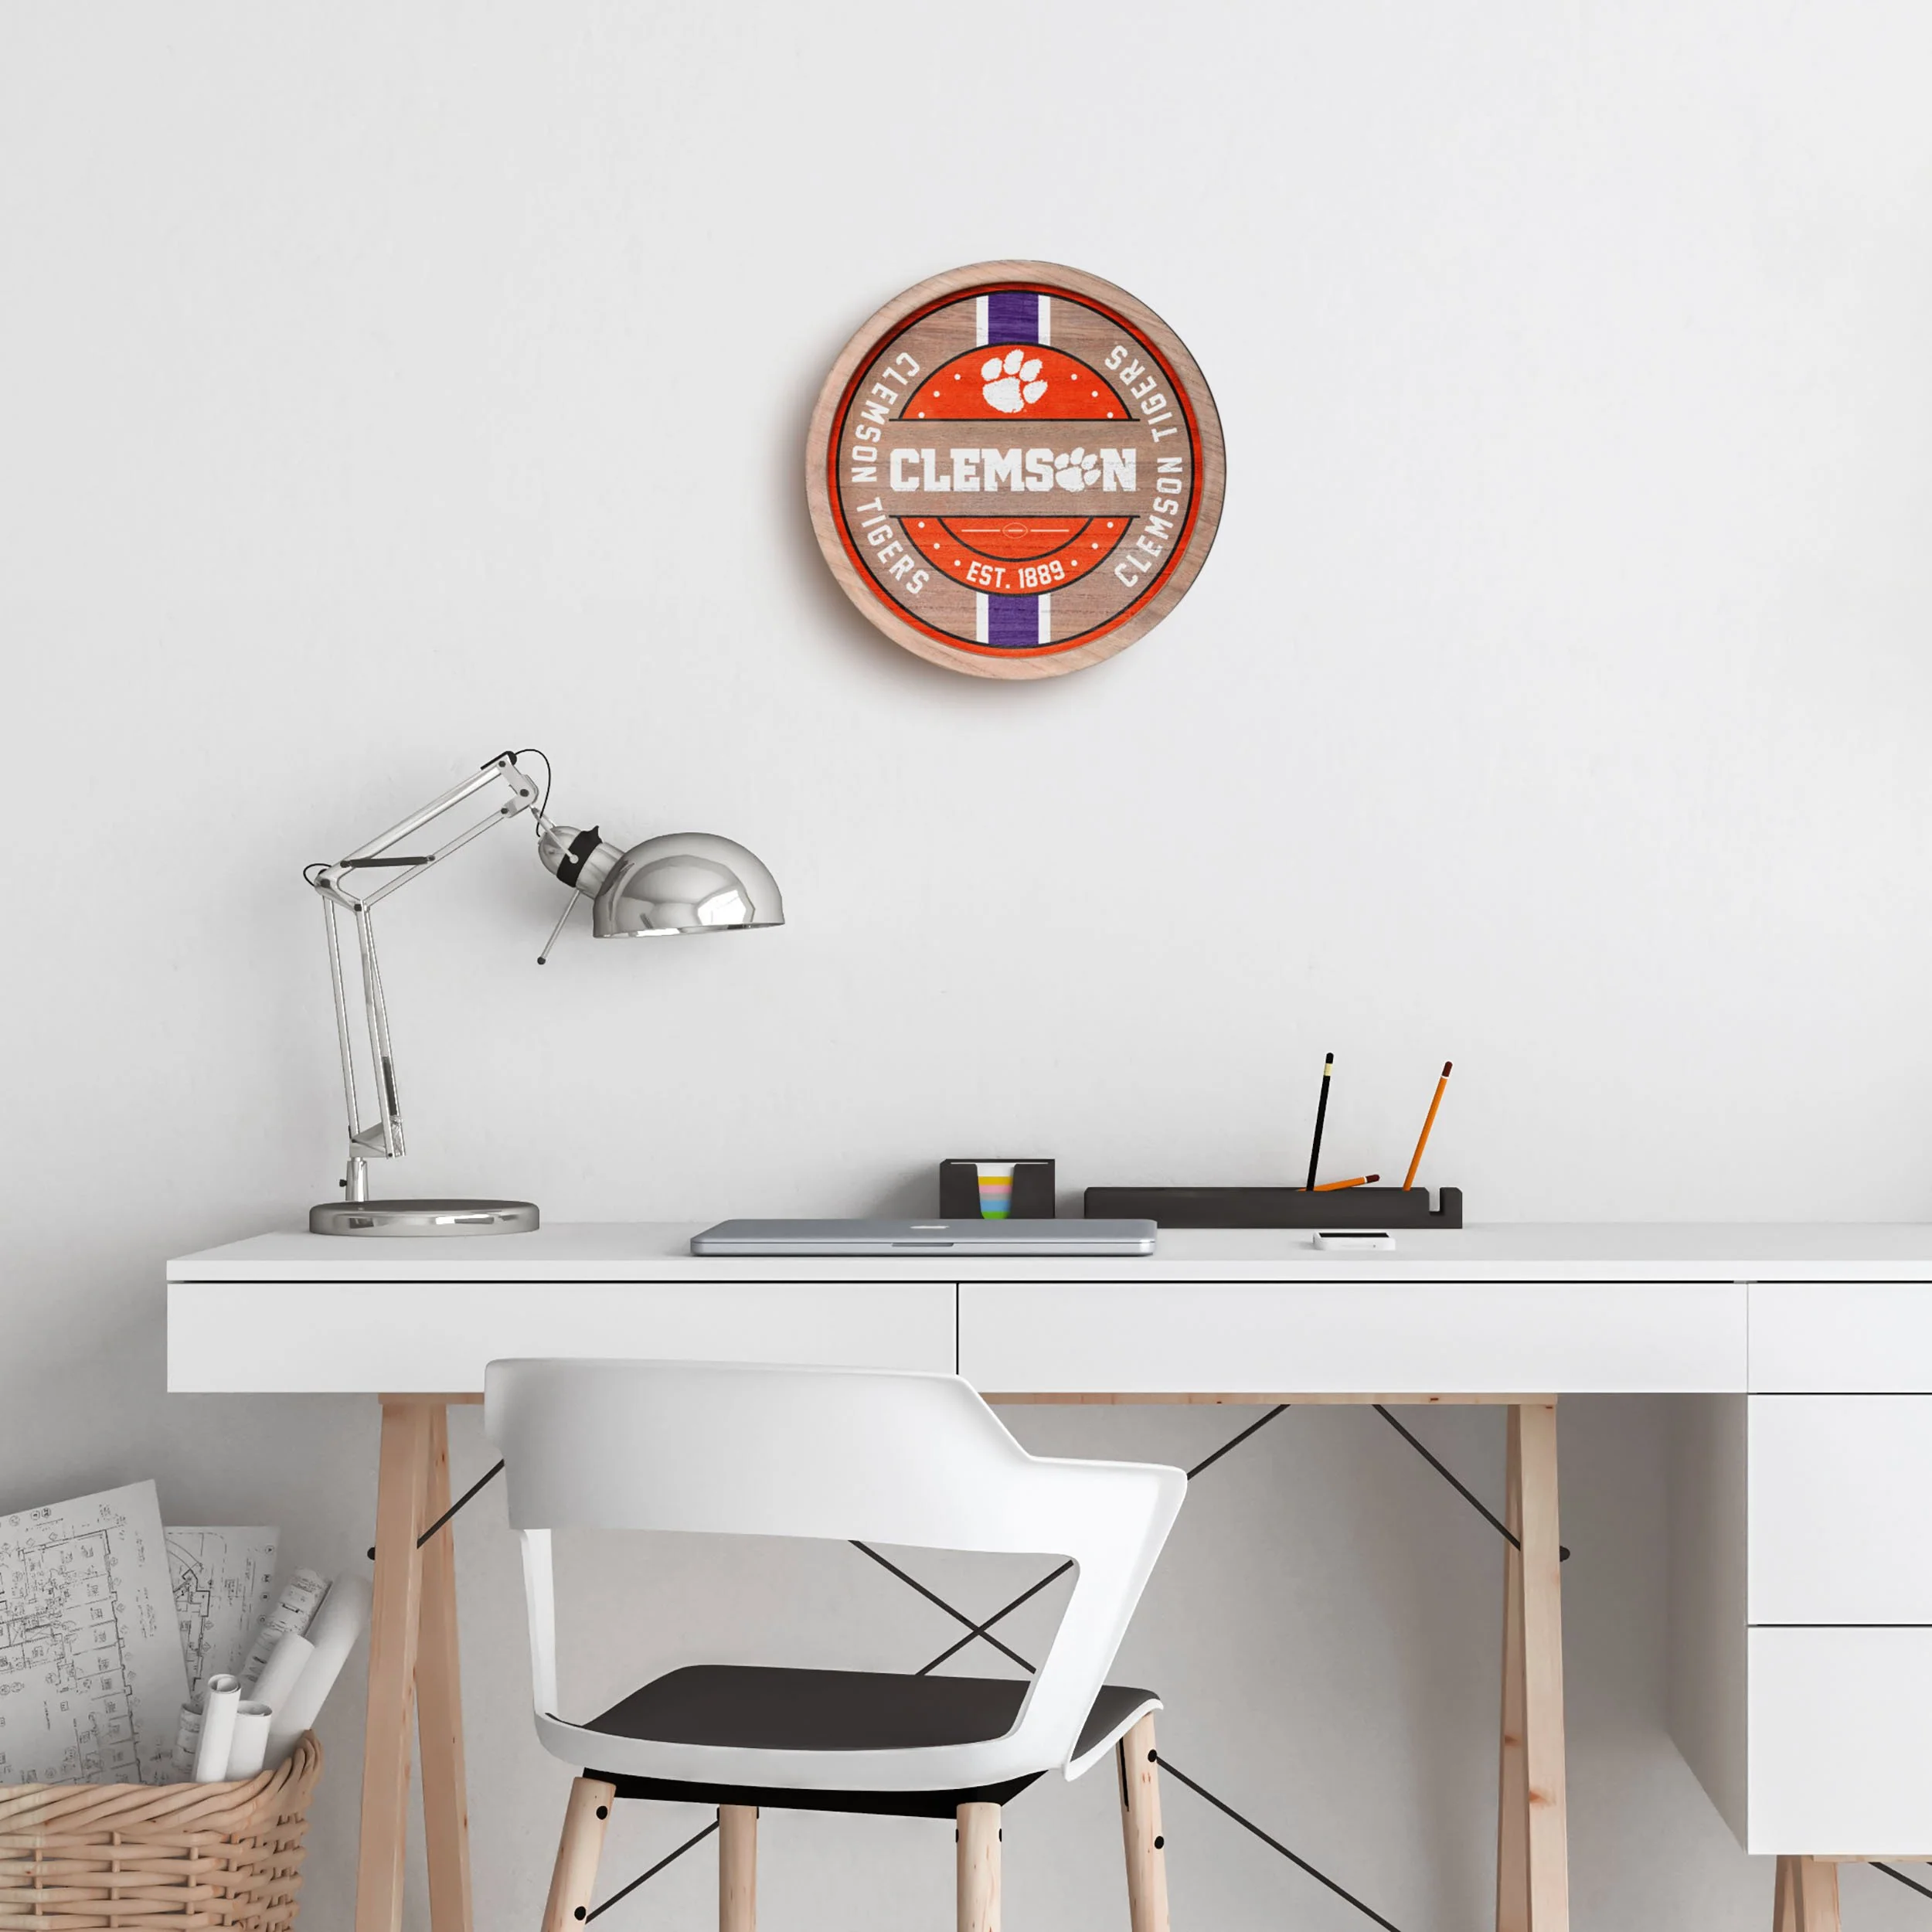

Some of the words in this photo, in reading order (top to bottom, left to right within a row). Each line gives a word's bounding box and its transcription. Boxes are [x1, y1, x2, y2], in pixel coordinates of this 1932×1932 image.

[851, 352, 920, 483] CLEMSON
[1104, 345, 1178, 443] TIGERS
[889, 447, 1138, 493] CLEMSN
[855, 497, 930, 594] TIGERS
[1113, 456, 1183, 588] CLEMSON
[966, 560, 1011, 589] EST.
[1018, 560, 1066, 589] 1889
